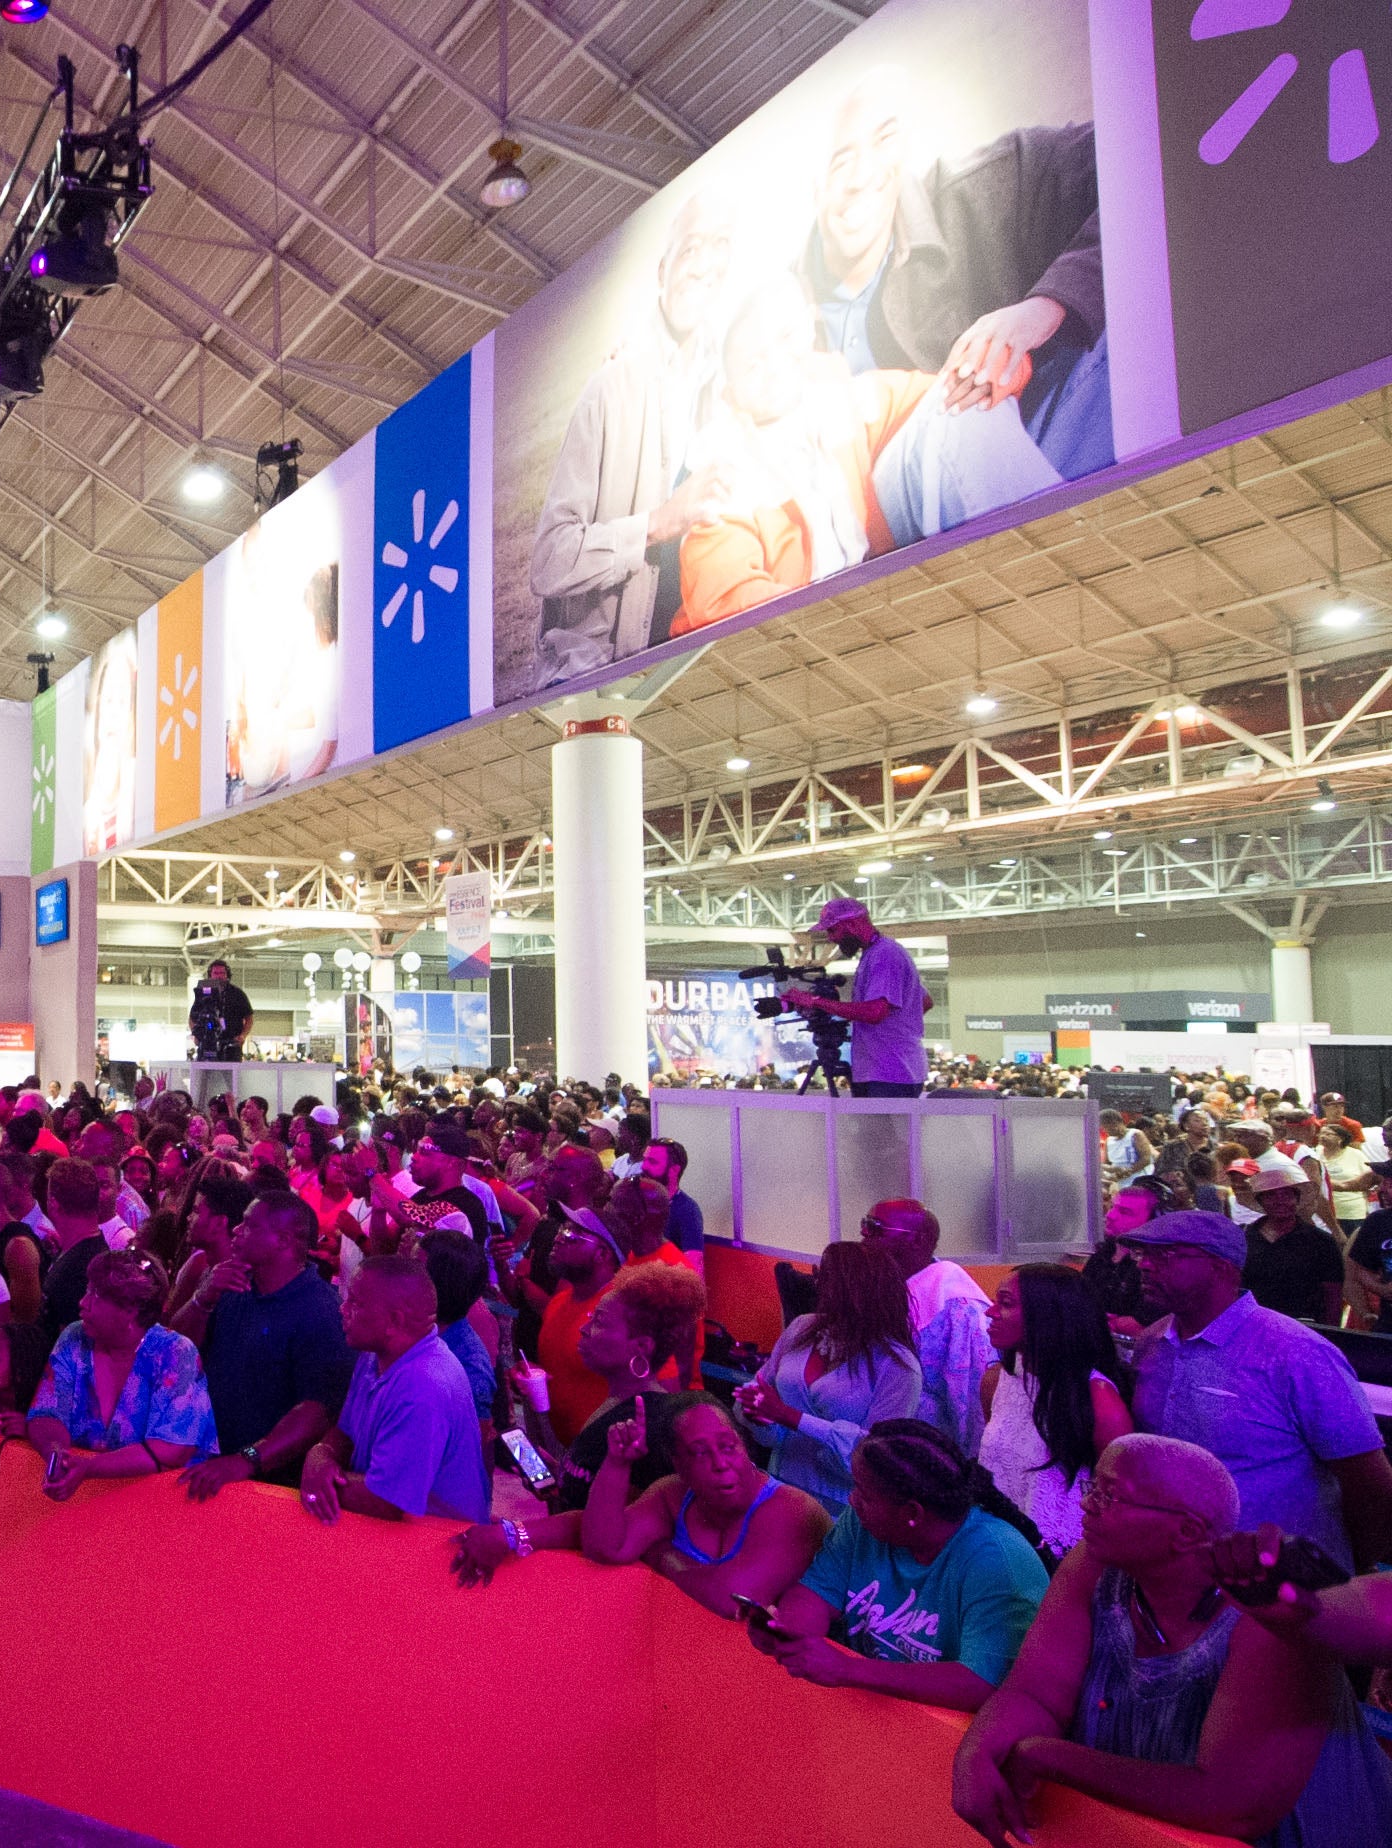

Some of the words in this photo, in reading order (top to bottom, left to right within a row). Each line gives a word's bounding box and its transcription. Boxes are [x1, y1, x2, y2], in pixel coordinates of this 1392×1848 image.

[449, 895, 485, 912] Festival
[645, 980, 775, 1012] DURBAN
[1048, 1002, 1113, 1015] verizon
[1187, 1000, 1241, 1017] verizon
[966, 1019, 1004, 1030] verizon
[1058, 1019, 1090, 1030] verizon
